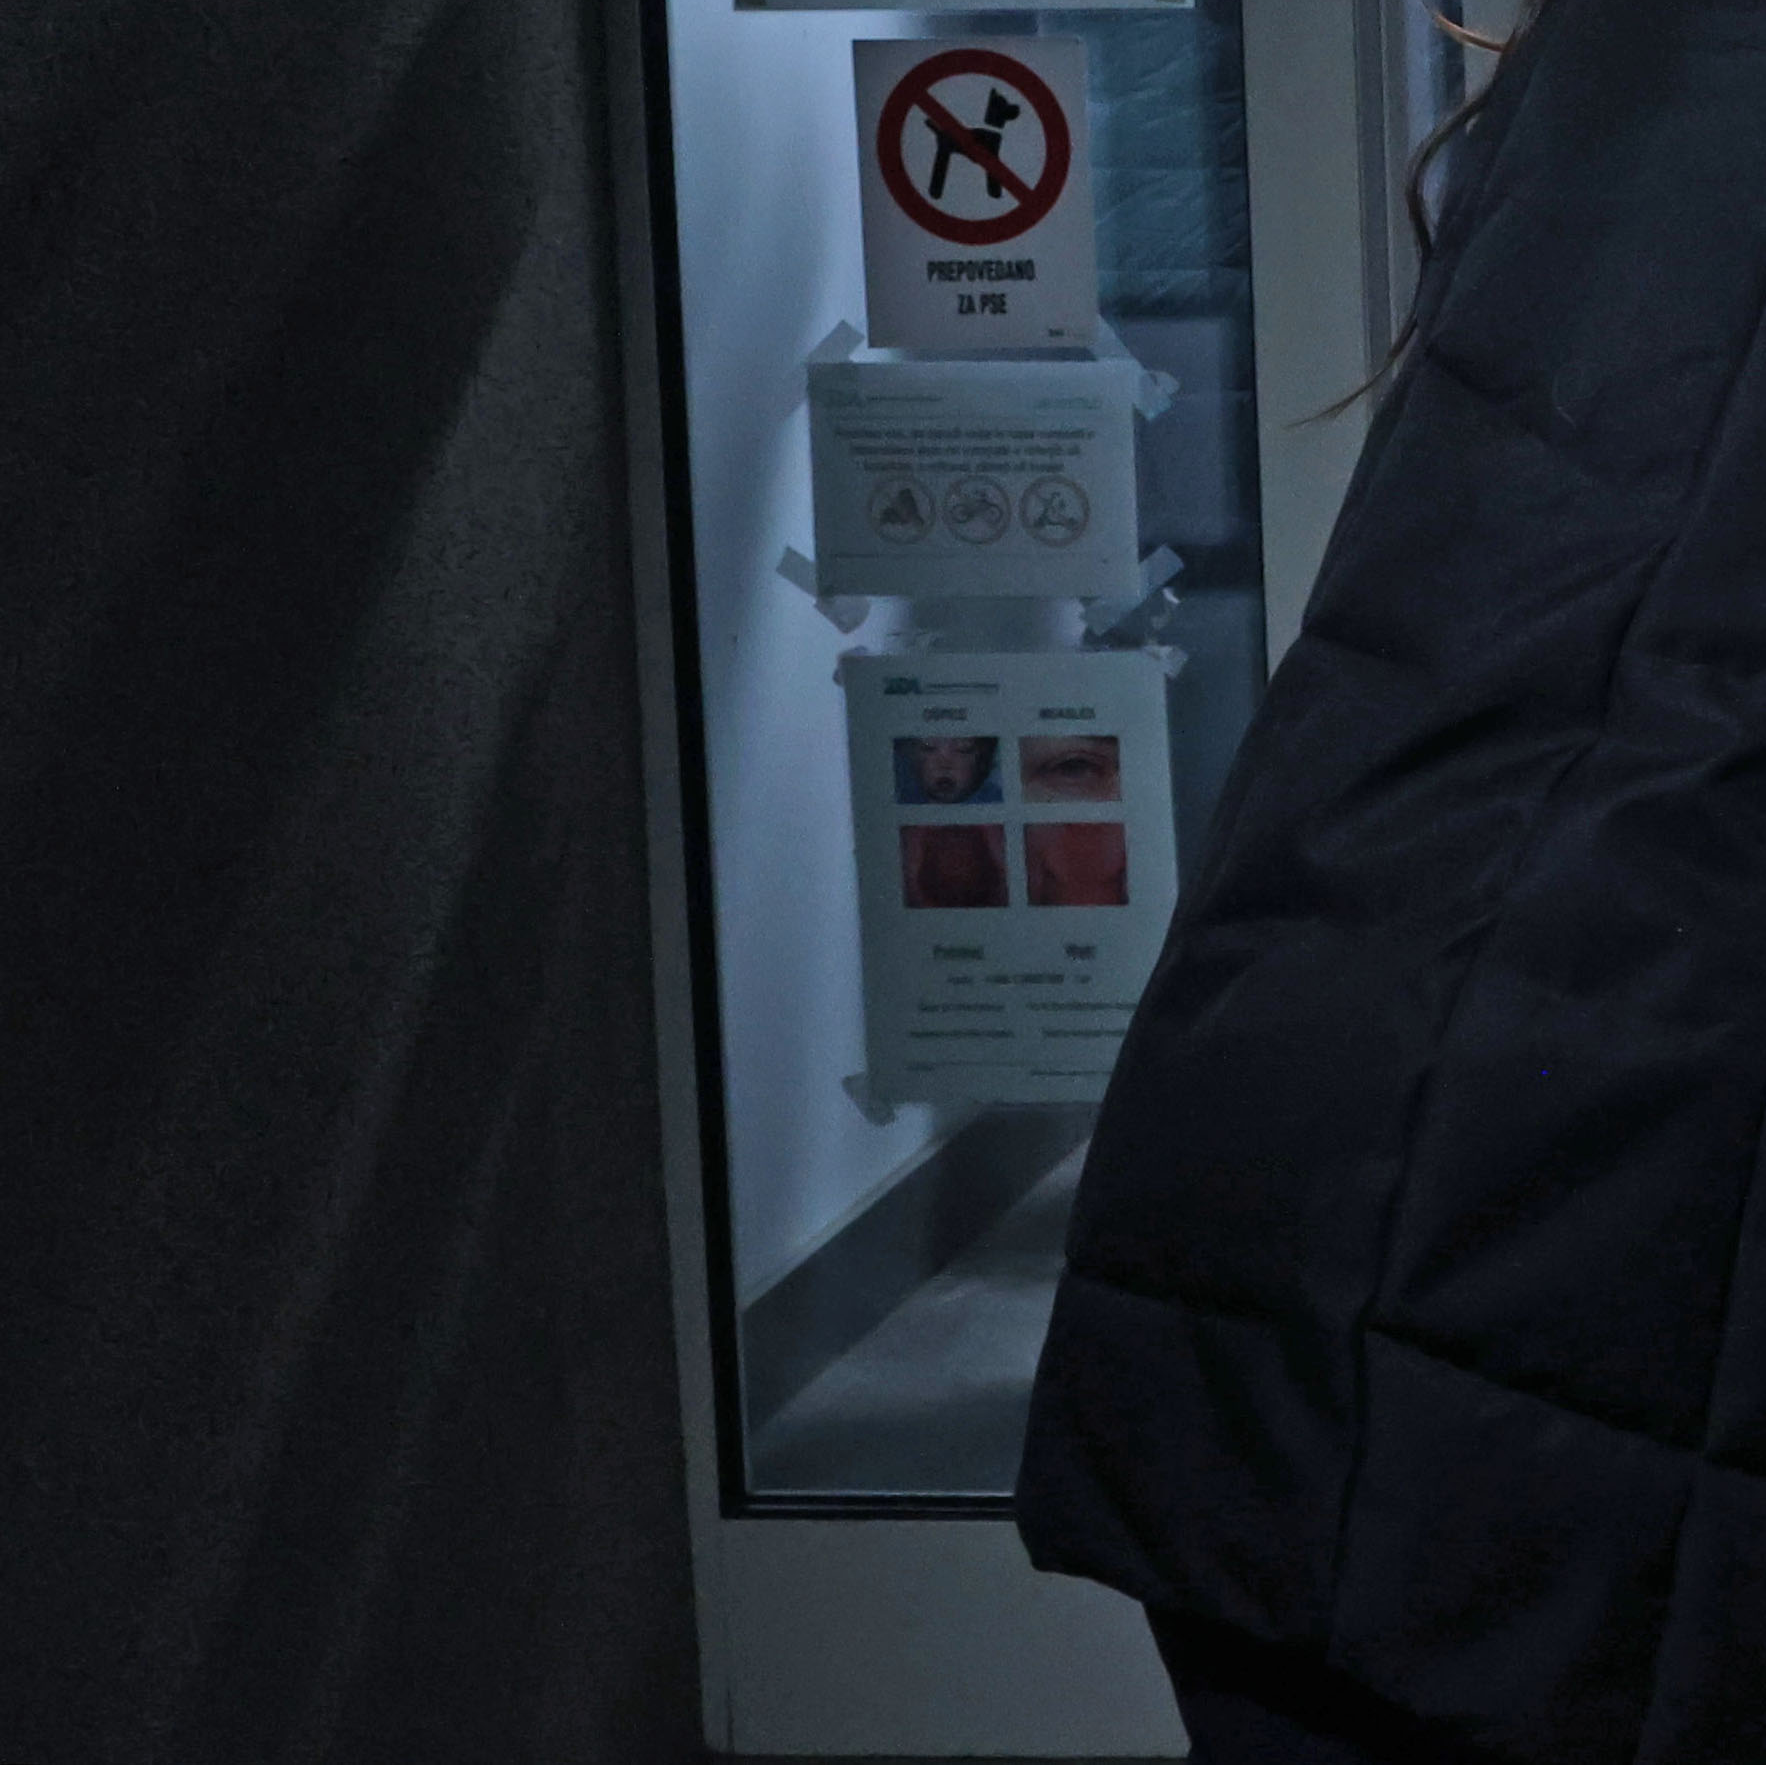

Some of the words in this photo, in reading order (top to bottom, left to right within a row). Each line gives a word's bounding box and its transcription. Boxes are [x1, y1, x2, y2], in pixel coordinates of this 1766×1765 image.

[926, 259, 1036, 283] PREPOVEDANO
[957, 293, 976, 315] ZA
[977, 292, 1008, 315] PSE
